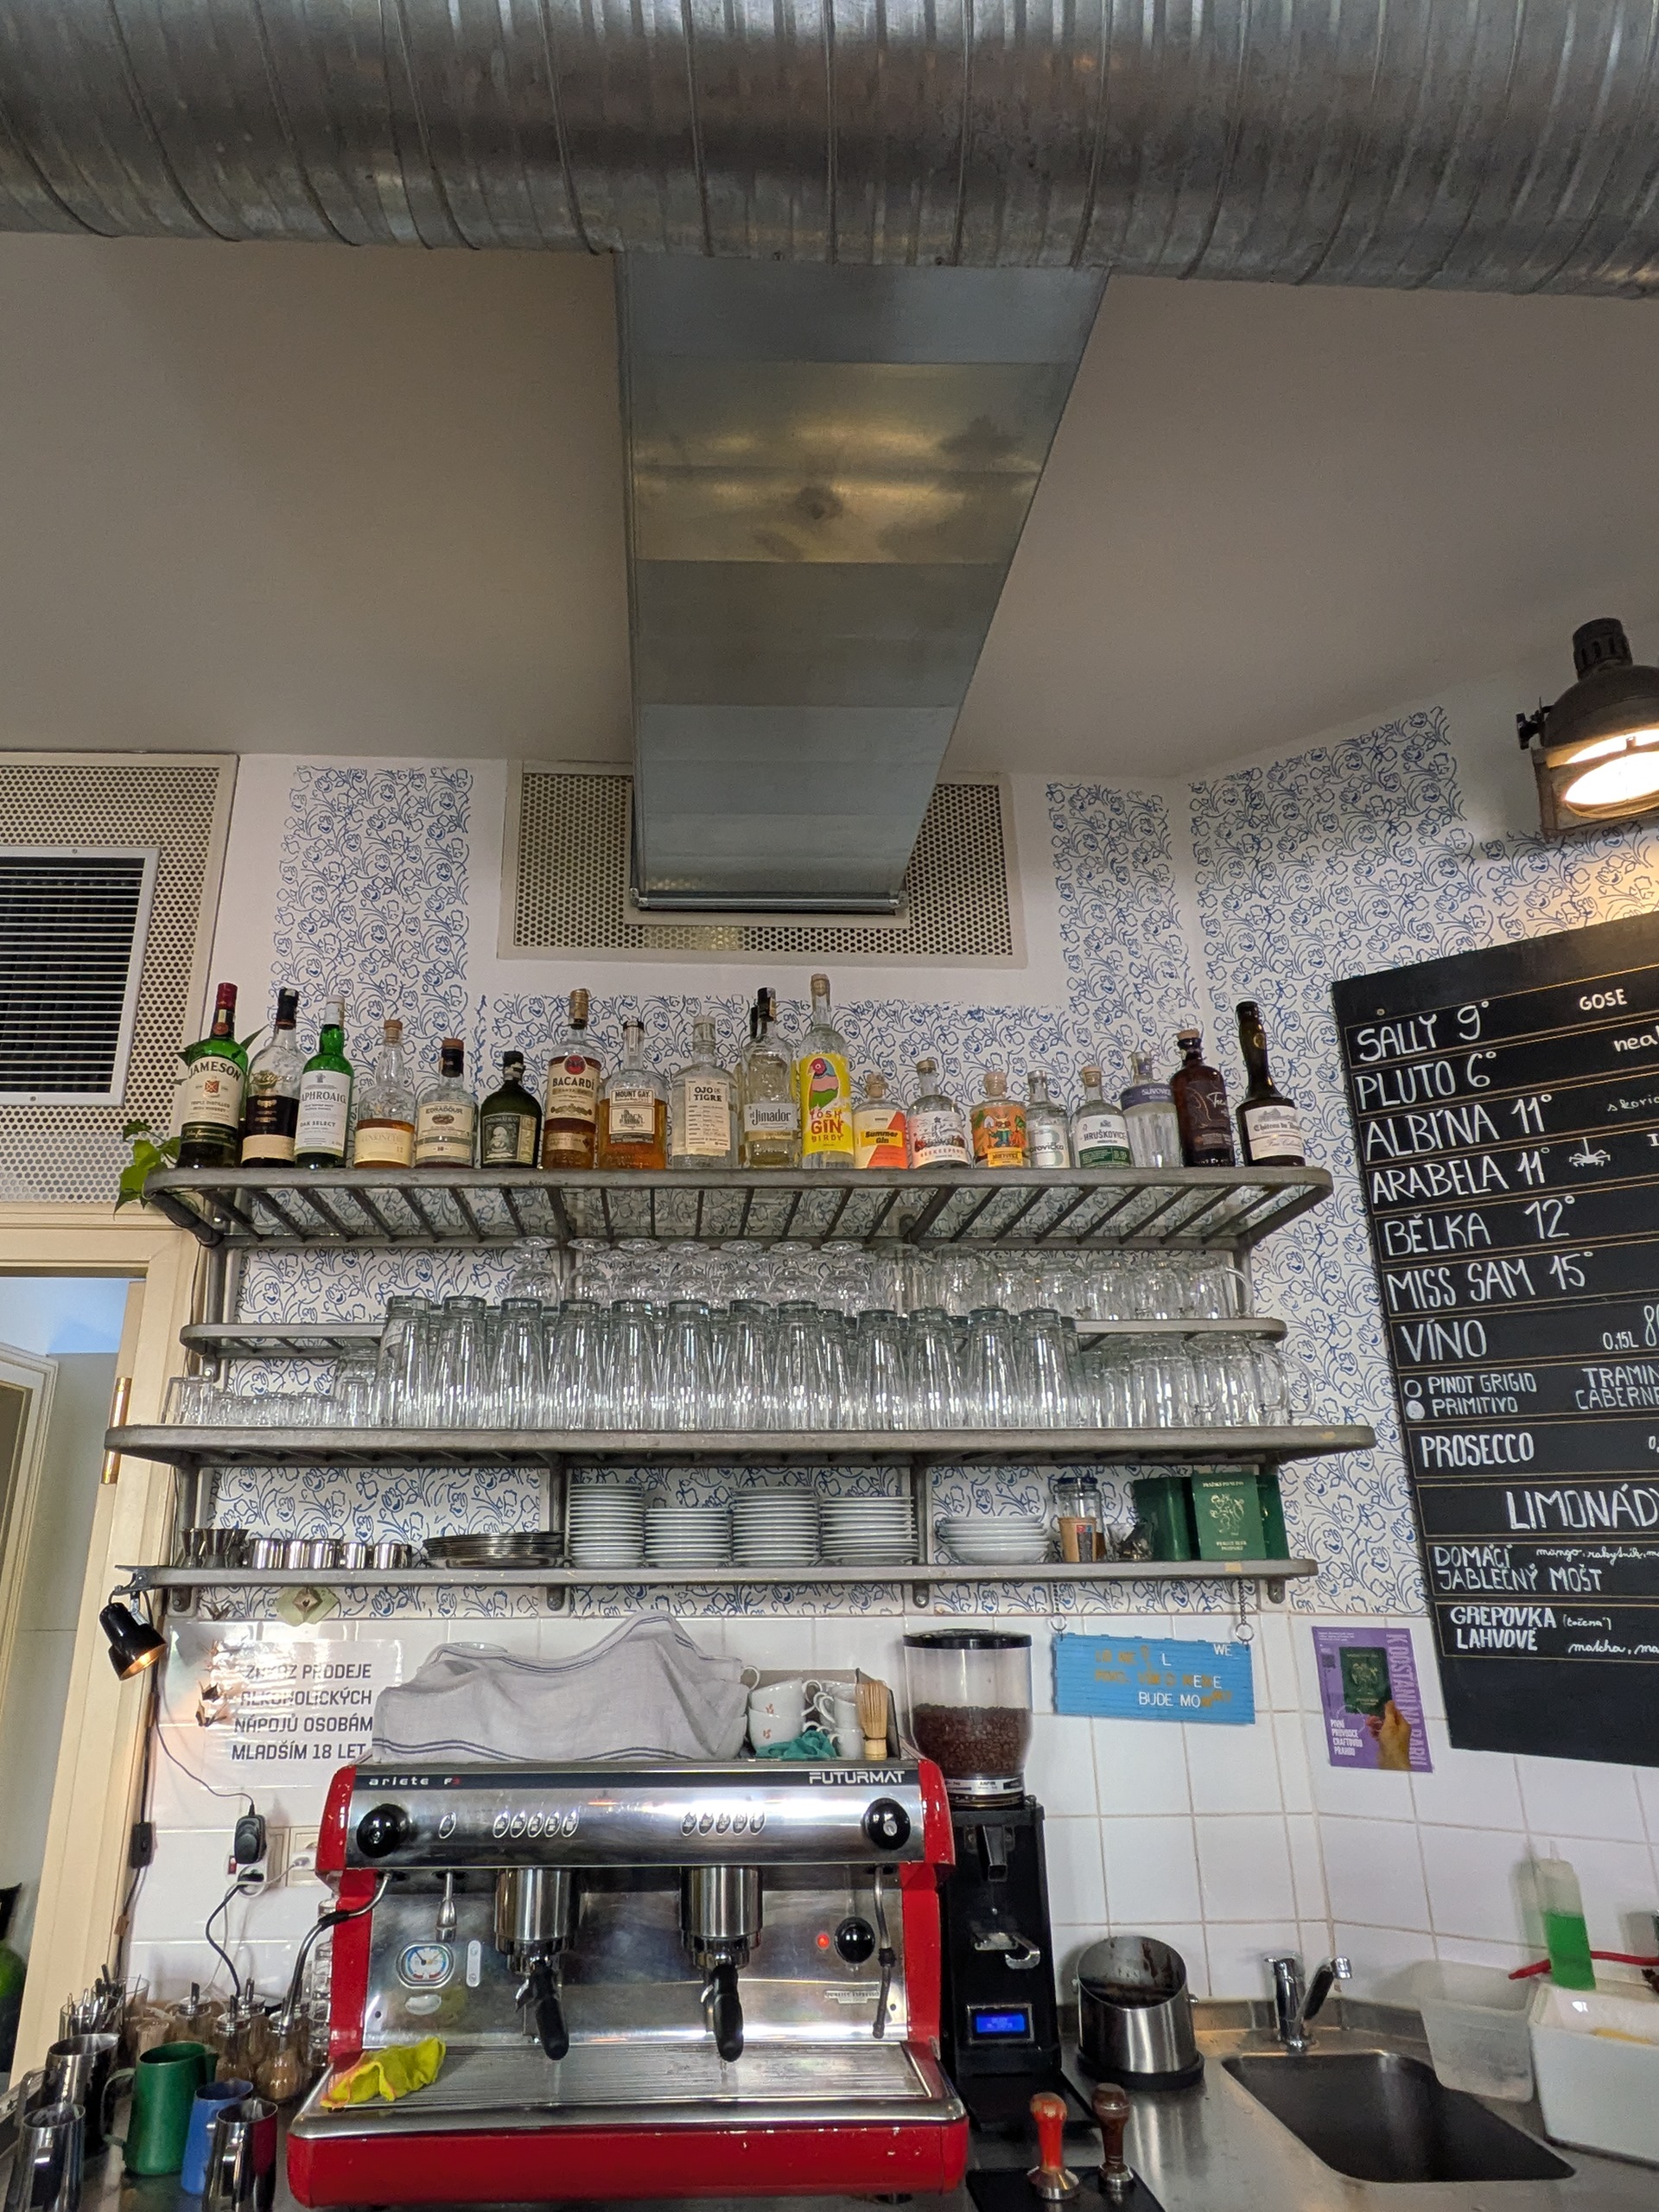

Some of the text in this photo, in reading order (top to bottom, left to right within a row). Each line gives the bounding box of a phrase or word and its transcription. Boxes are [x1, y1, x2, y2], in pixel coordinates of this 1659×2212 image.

[1579, 988, 1628, 1011] GOSE
[1357, 1000, 1490, 1062] SALLY 9°
[189, 1061, 241, 1082] JAMESON
[1355, 1051, 1497, 1110] PLUTO 6°
[693, 1094, 722, 1103] TIGRE
[1366, 1103, 1500, 1161] ALBÍNA
[1372, 1155, 1510, 1205] ARABELA
[1384, 1195, 1576, 1256] BĚLKA 12°
[1387, 1251, 1594, 1312] MISS SAM 15°
[1401, 1318, 1488, 1362] VÍNO
[1427, 1372, 1537, 1395] PINOT GRIGIO
[1432, 1396, 1518, 1418] PRIMITIVO
[1421, 1432, 1535, 1468] PROSECCO
[1548, 1563, 1602, 1592] MOŠT
[1450, 1605, 1557, 1629] GREPOVKA
[1213, 1643, 1232, 1656] WE
[302, 1663, 372, 1680] PRODEJE
[1139, 1691, 1173, 1707] BUDE
[234, 1713, 373, 1733] NÁPOJŮ OSOBÁM
[232, 1739, 366, 1760] MLADŠÍM 18 LET
[368, 1776, 429, 1786] ariete
[809, 1770, 906, 1784] FUTURMAT
